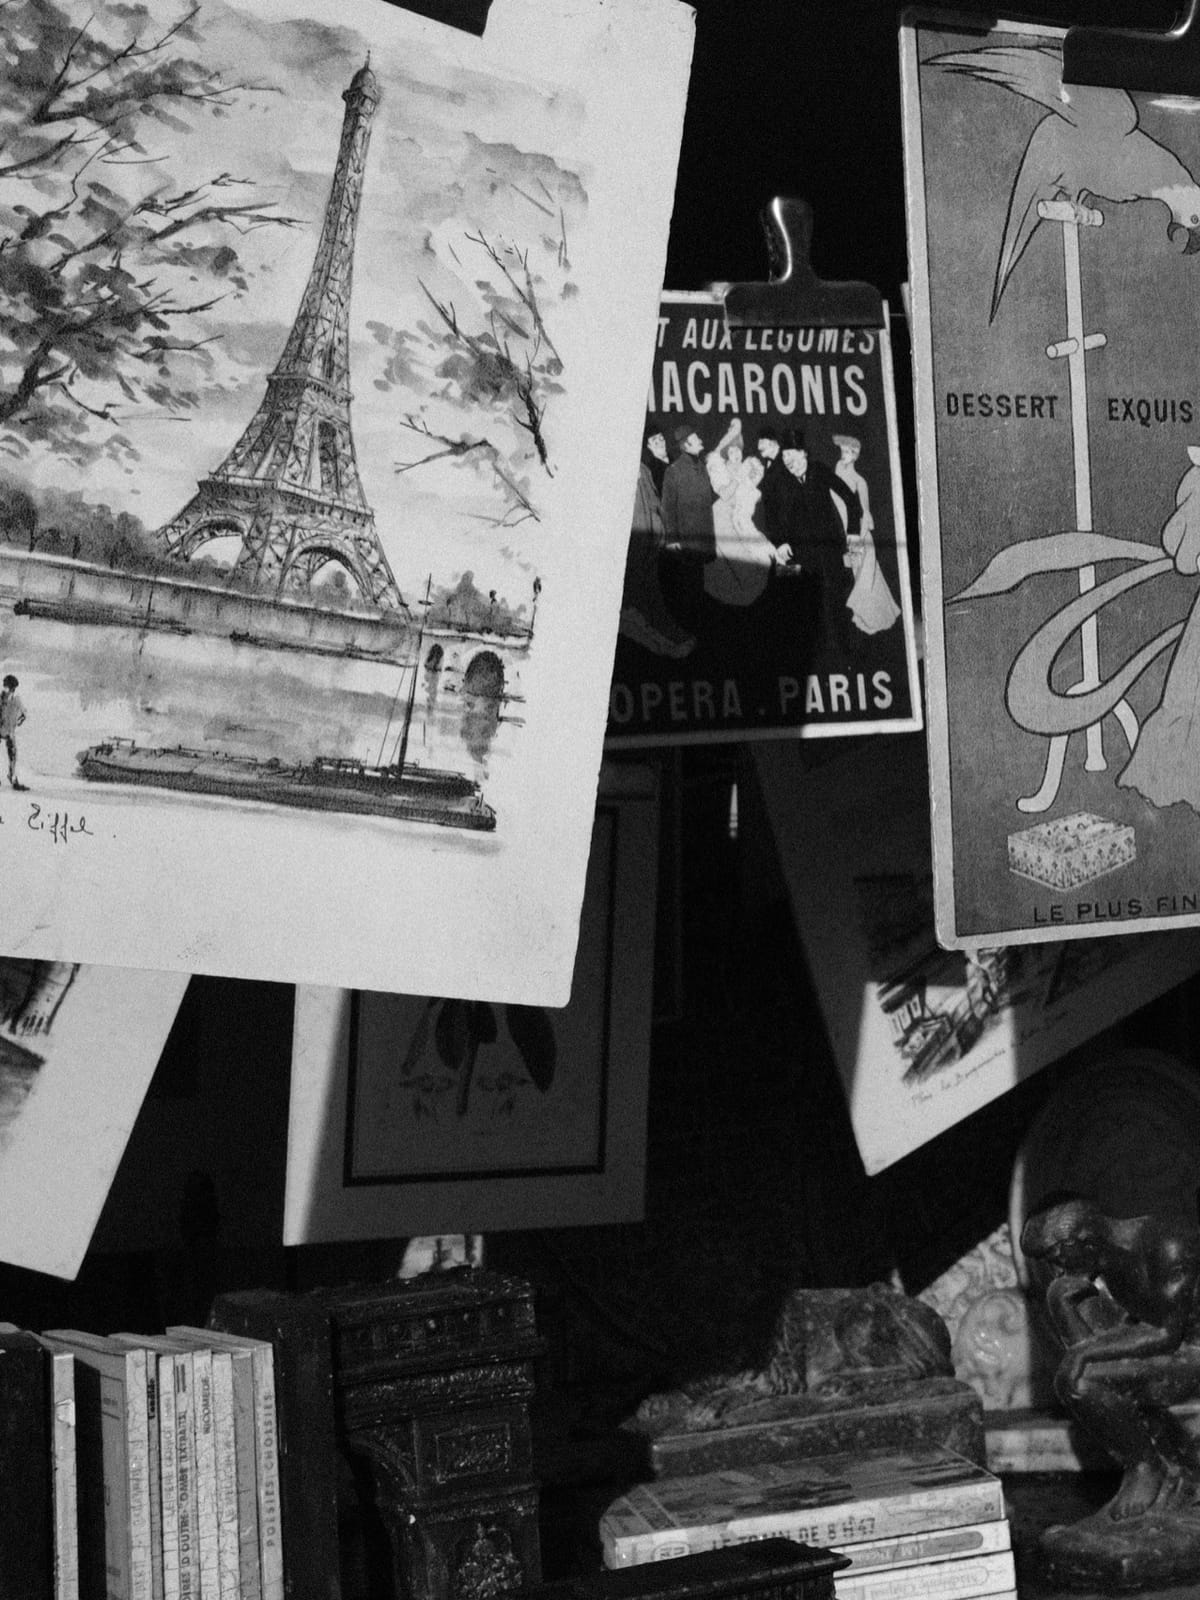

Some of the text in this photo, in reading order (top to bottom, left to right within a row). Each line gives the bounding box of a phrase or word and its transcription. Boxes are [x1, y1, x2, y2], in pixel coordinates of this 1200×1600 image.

[682, 318, 732, 350] AUX
[946, 392, 1059, 420] DESSERT
[1107, 397, 1194, 427] EXQUIS
[610, 670, 894, 724] OPERA PARIS
[28, 803, 94, 844] Eiffel
[1034, 903, 1064, 924] LE
[1077, 898, 1142, 921] PLUS
[1156, 894, 1197, 913] FIN
